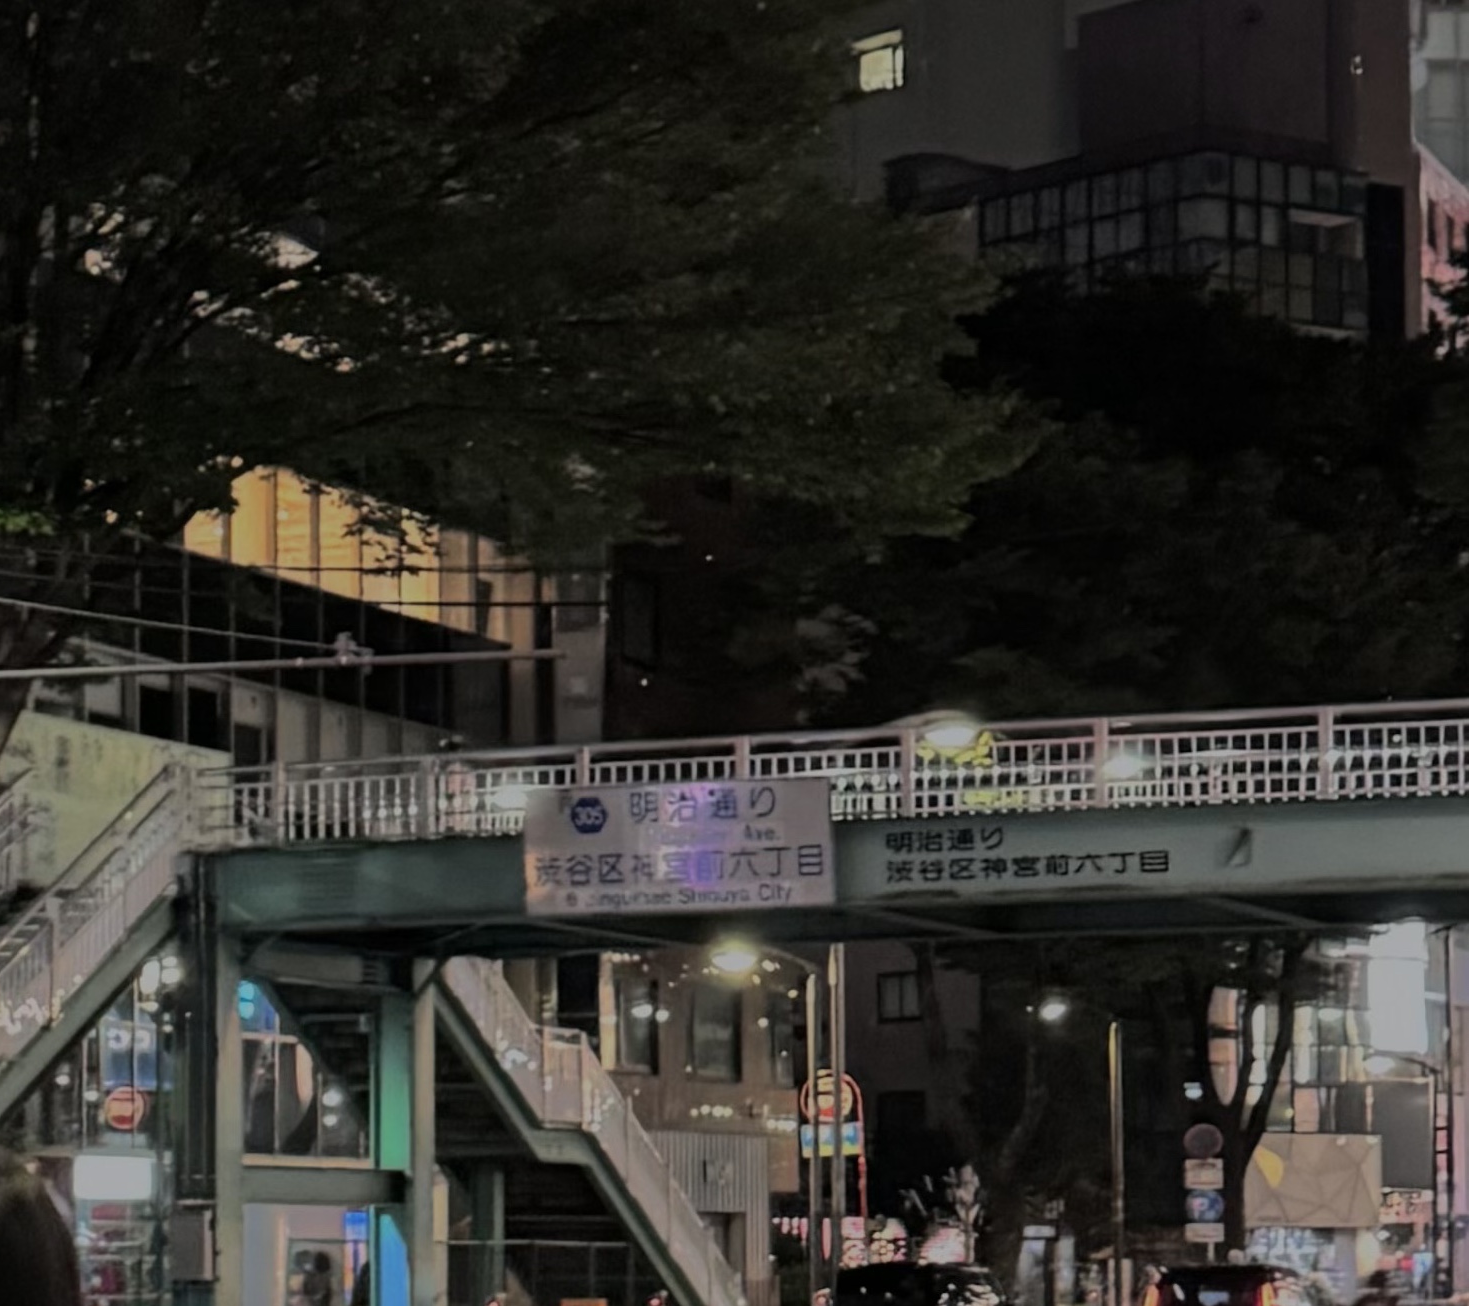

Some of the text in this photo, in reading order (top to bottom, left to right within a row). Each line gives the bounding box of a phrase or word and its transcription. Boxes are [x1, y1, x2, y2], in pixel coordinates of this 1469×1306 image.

[630, 786, 777, 823] 明治通り
[885, 826, 1004, 854] 明治通り
[534, 844, 824, 887] 渋谷区神宮前六丁目
[886, 850, 1170, 883] 渋谷区神宮前六丁目
[757, 884, 793, 903] City
